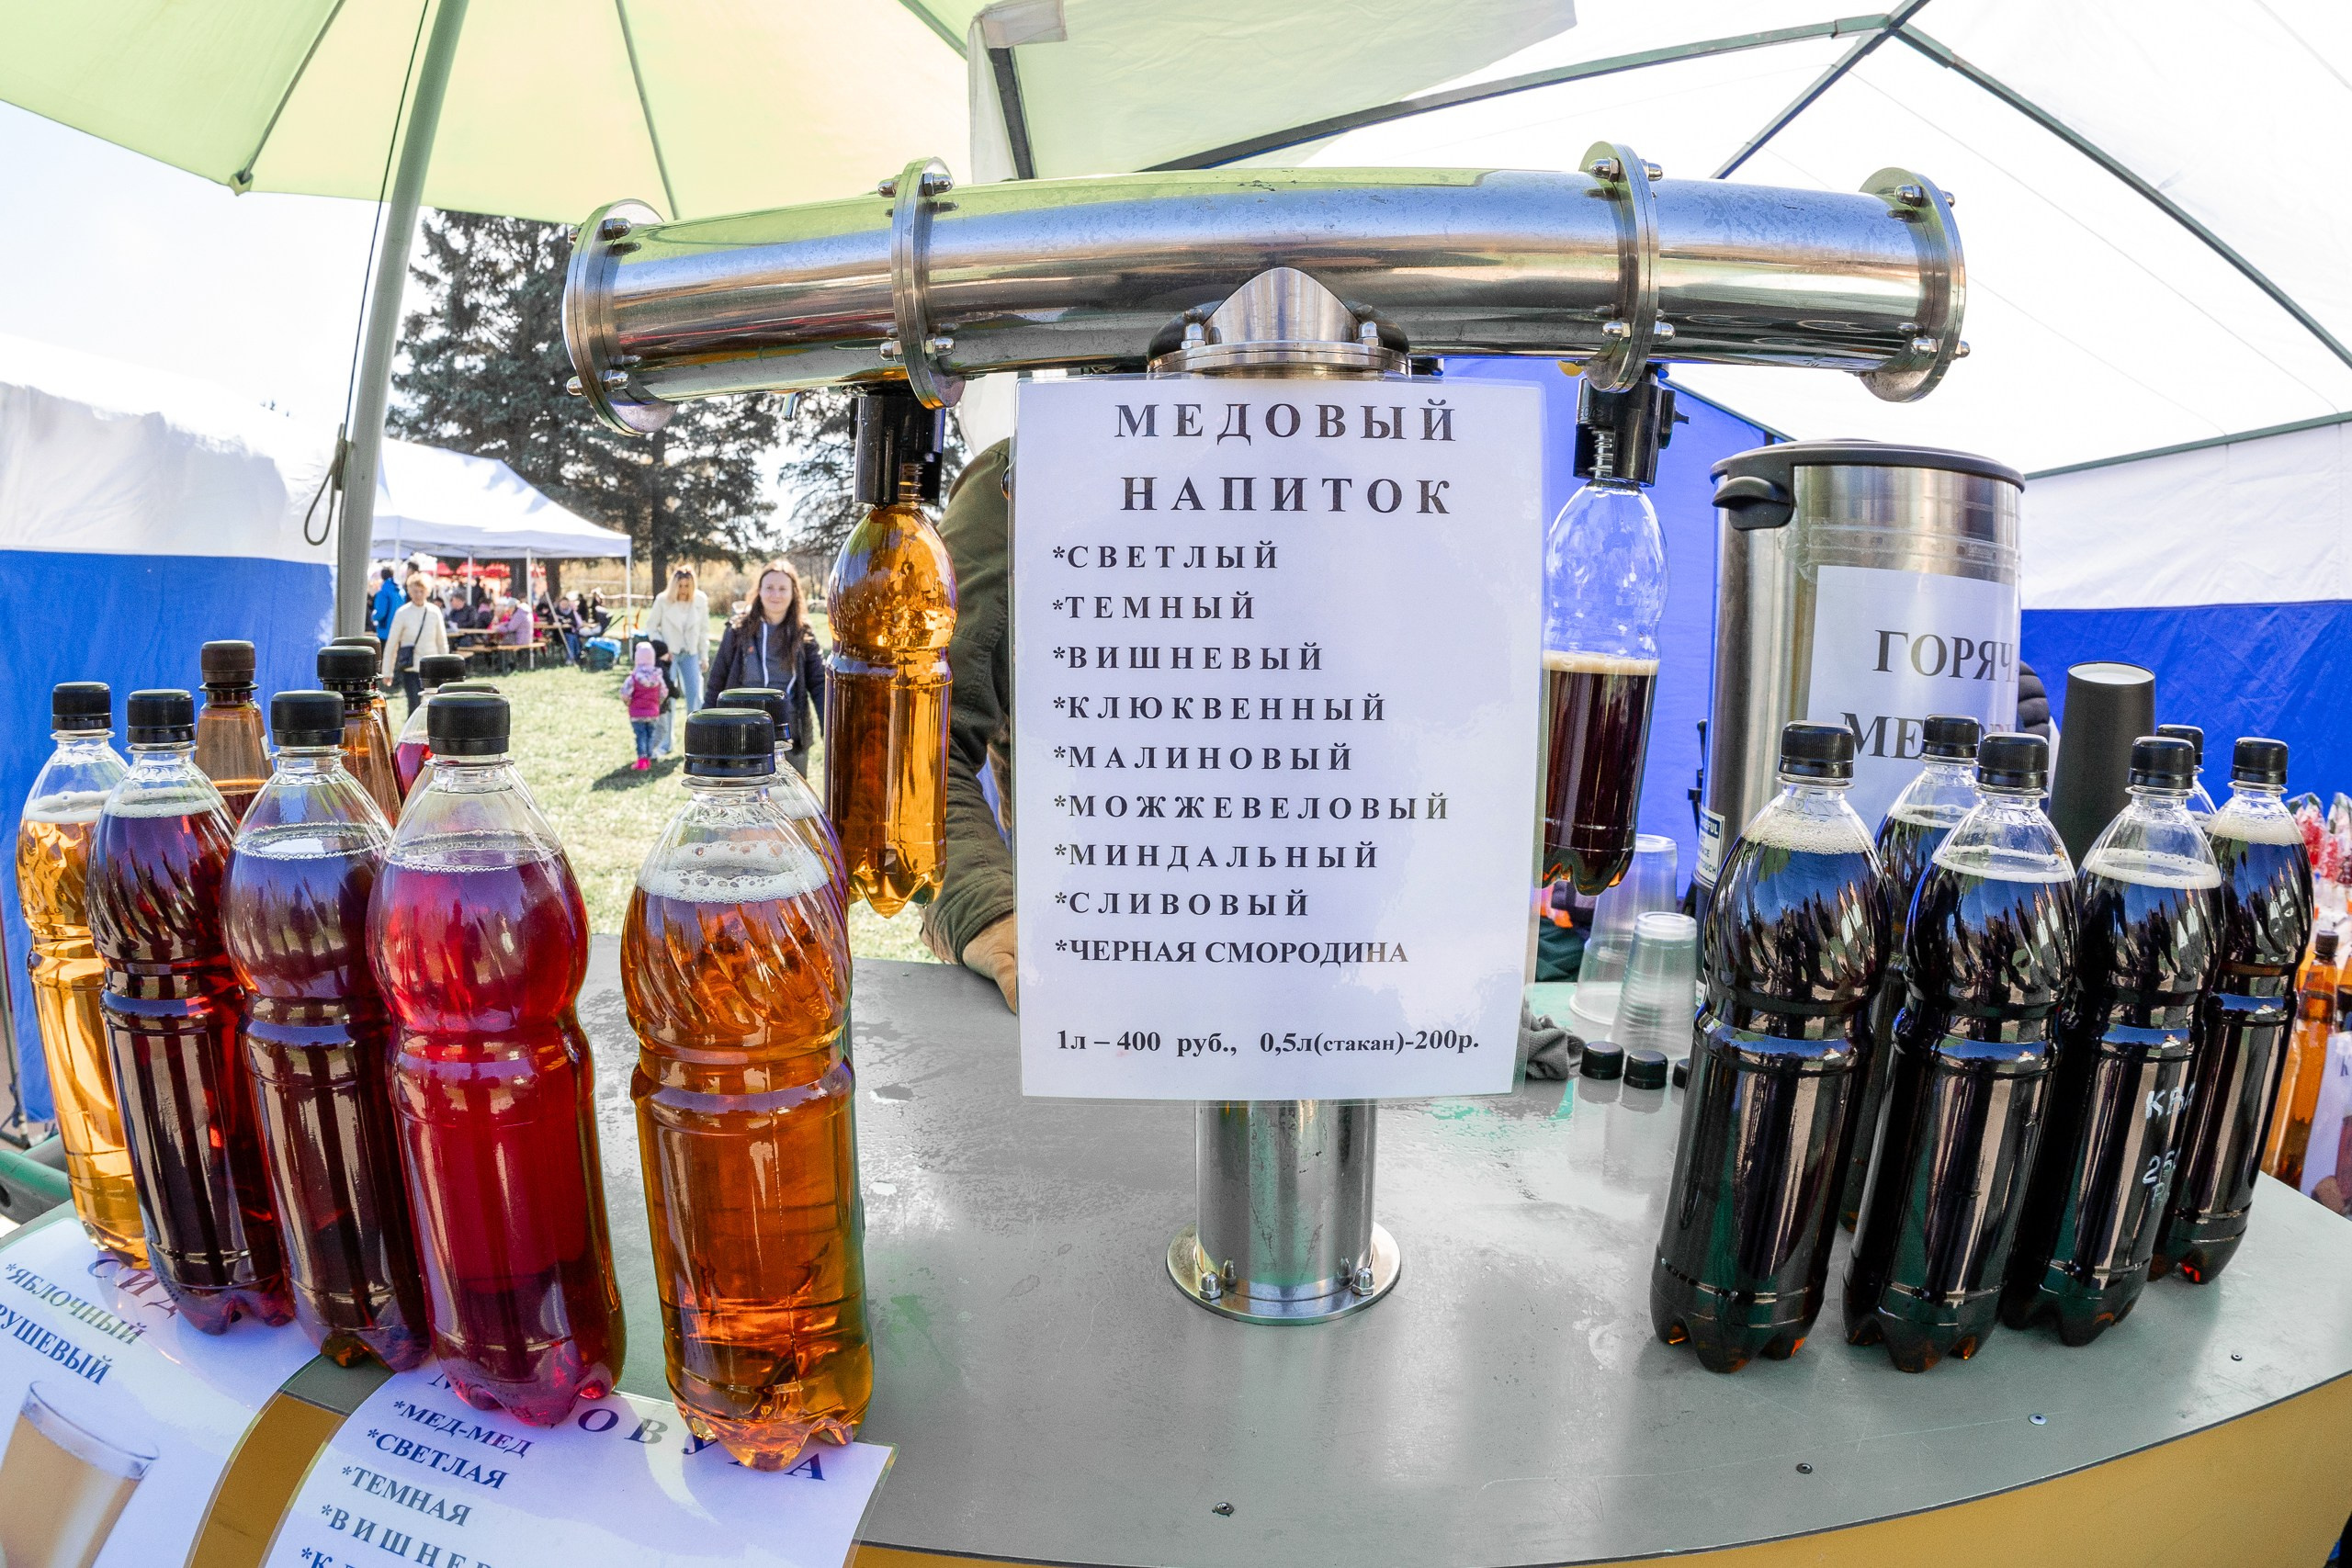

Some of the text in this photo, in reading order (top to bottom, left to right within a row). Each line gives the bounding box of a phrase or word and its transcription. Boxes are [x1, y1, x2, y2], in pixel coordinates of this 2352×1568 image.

[1114, 399, 1456, 446] МЕДОВЫЙ
[1120, 476, 1451, 514] НАПИТОК
[1872, 629, 2015, 682] ГОРЯЧ
[1204, 942, 1408, 968] СМОРОДИНА
[1057, 1030, 1087, 1051] 1л
[1116, 1031, 1161, 1052] 400
[1176, 1032, 1238, 1057] руб.,
